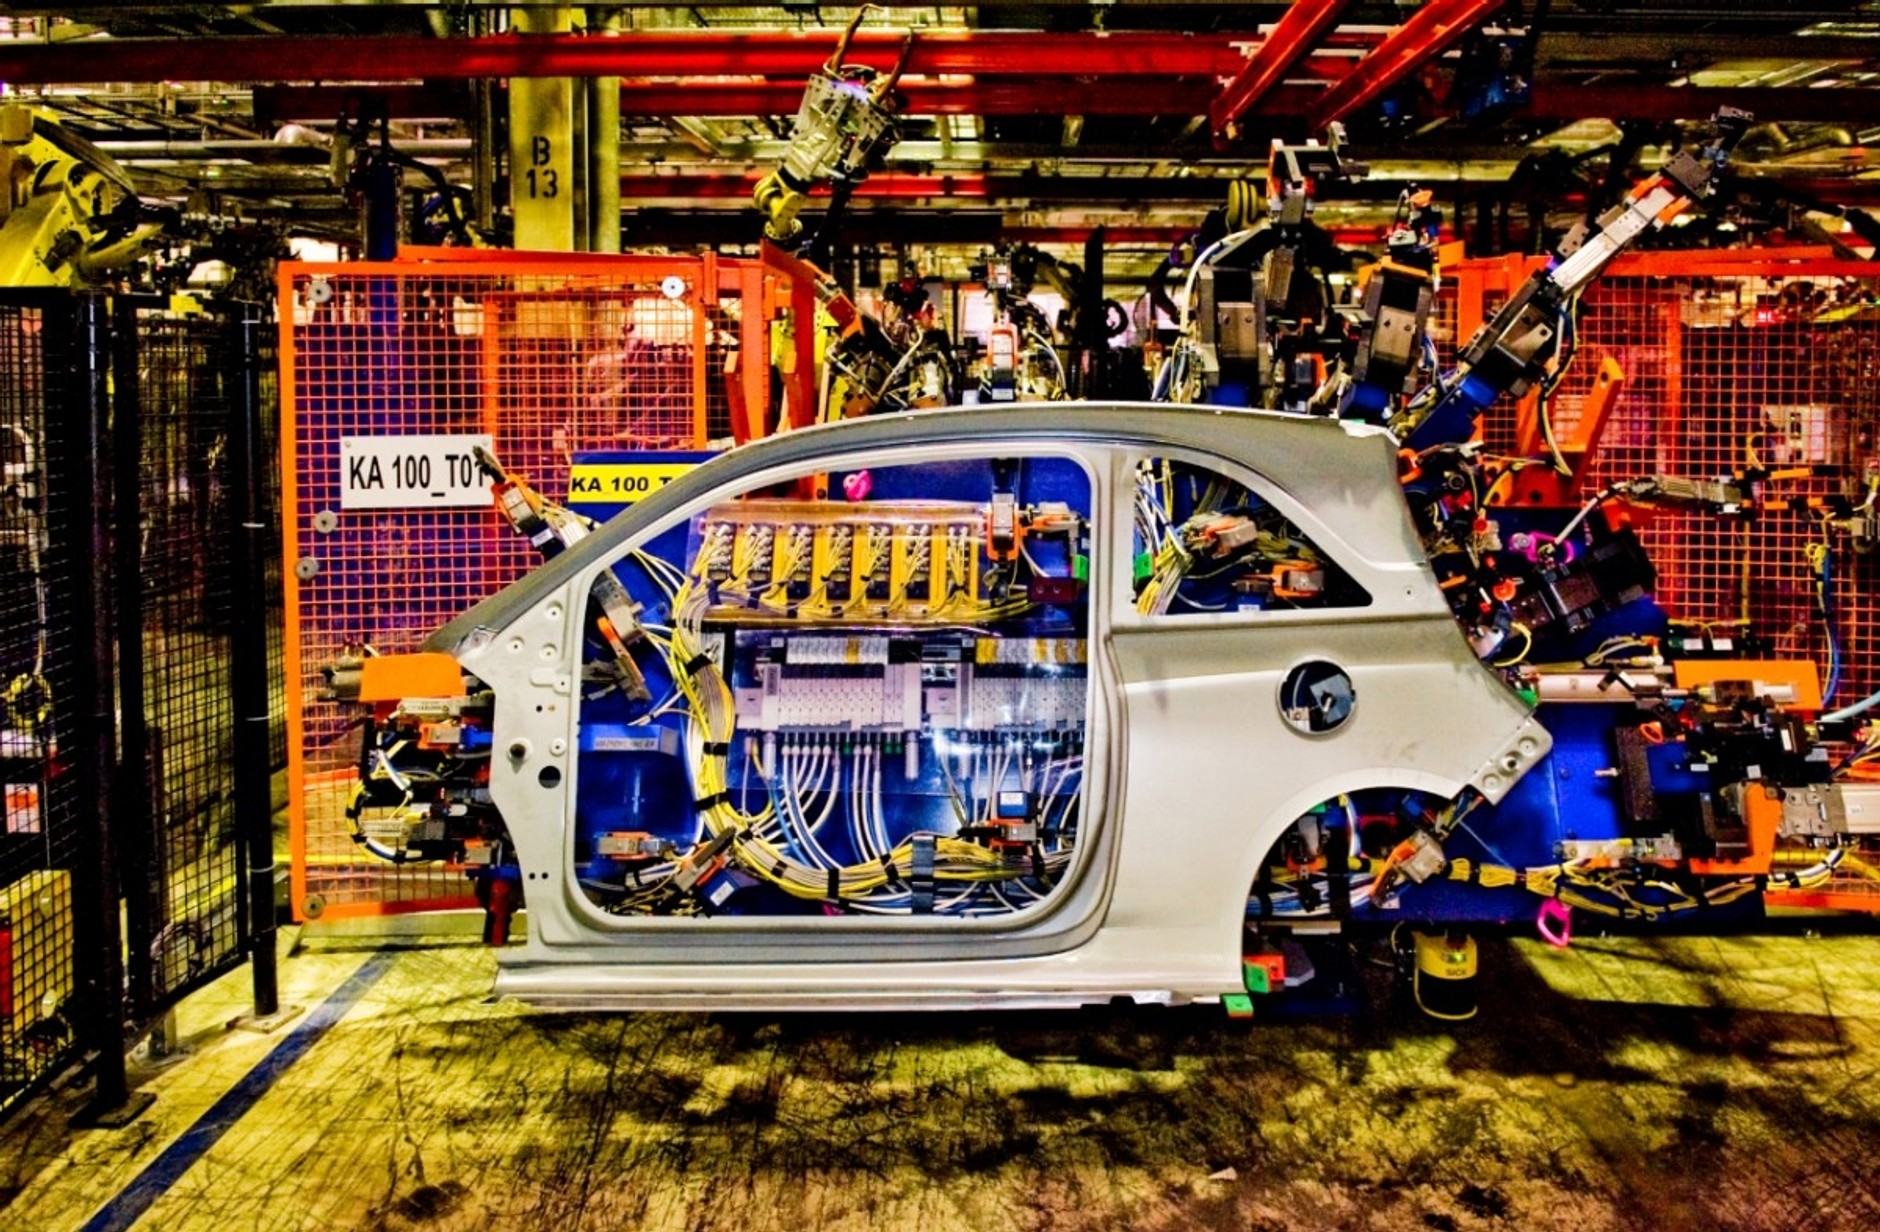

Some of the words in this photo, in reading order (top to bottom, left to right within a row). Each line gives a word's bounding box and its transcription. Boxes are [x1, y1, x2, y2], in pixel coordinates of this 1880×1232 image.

[532, 136, 550, 166] B
[526, 169, 558, 199] 13
[349, 455, 384, 489] KA
[571, 477, 602, 492] KA
[611, 476, 649, 492] 100
